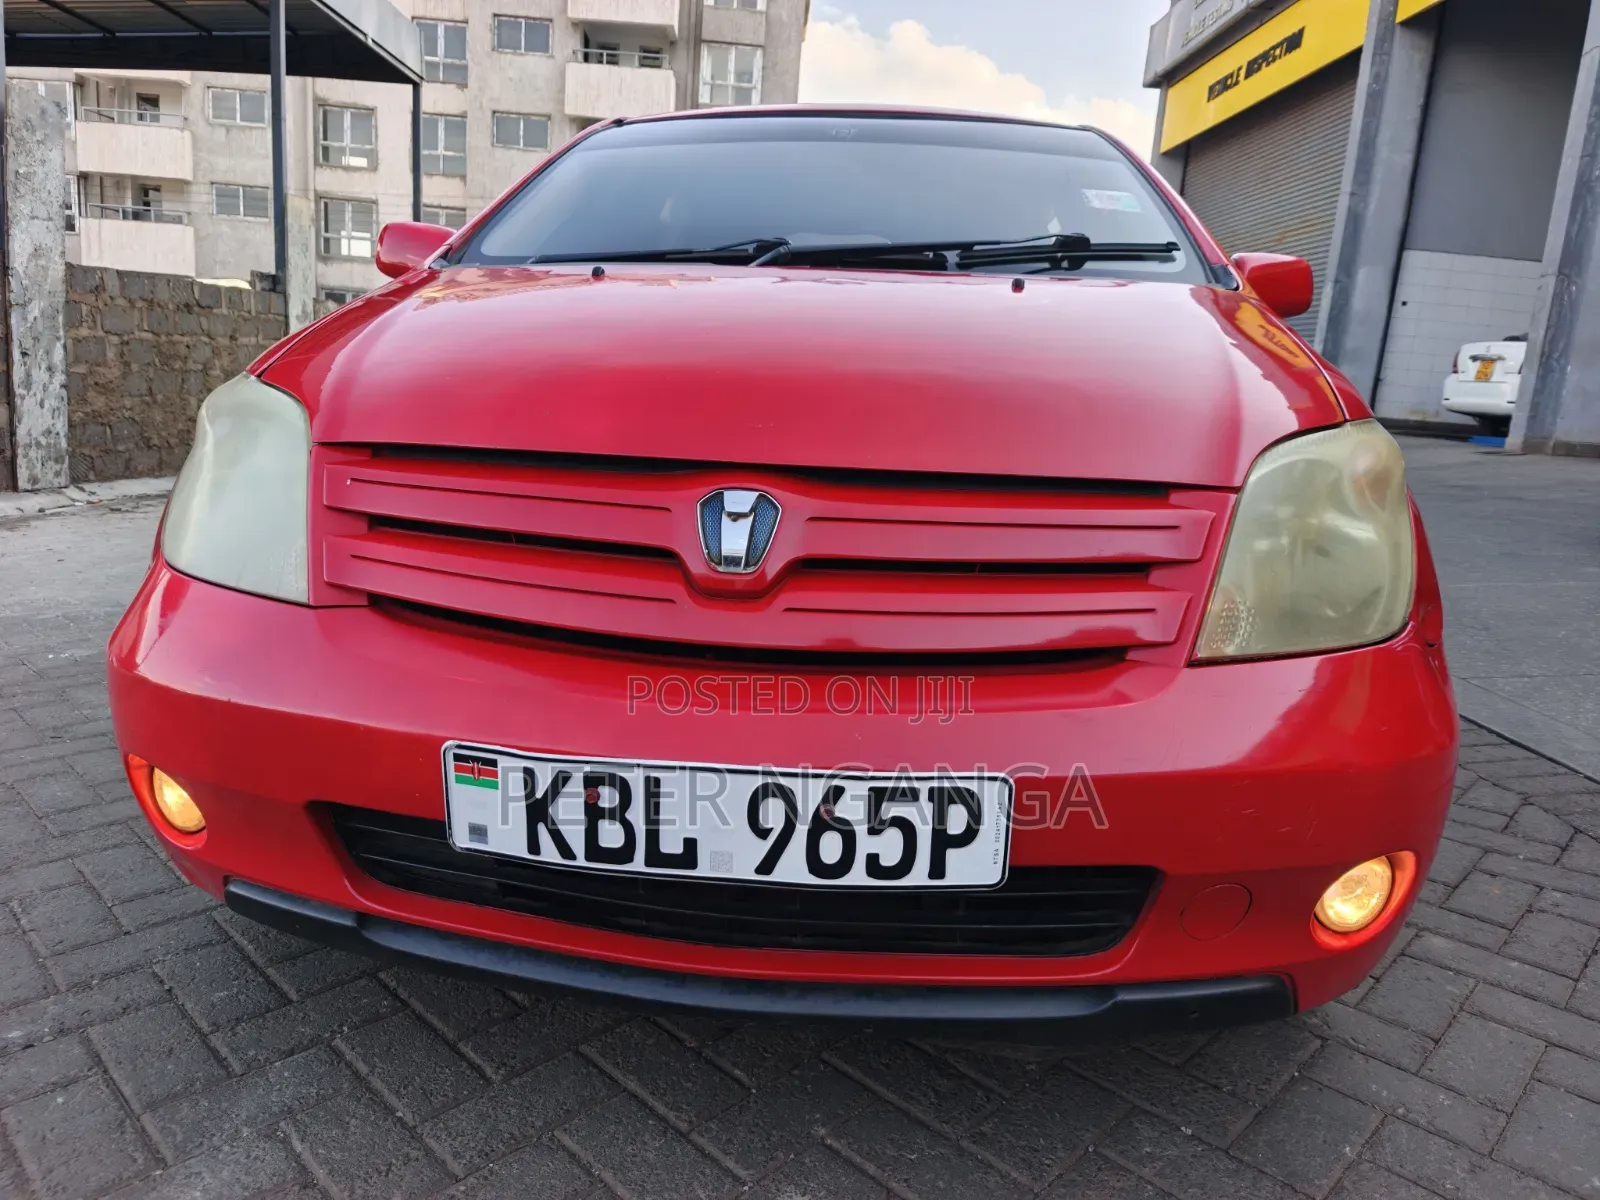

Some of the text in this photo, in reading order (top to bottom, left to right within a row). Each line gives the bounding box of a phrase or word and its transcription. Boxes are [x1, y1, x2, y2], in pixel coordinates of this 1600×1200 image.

[1207, 25, 1306, 103] VEHICLE INSPECTION
[523, 766, 982, 880] KBL 965P
